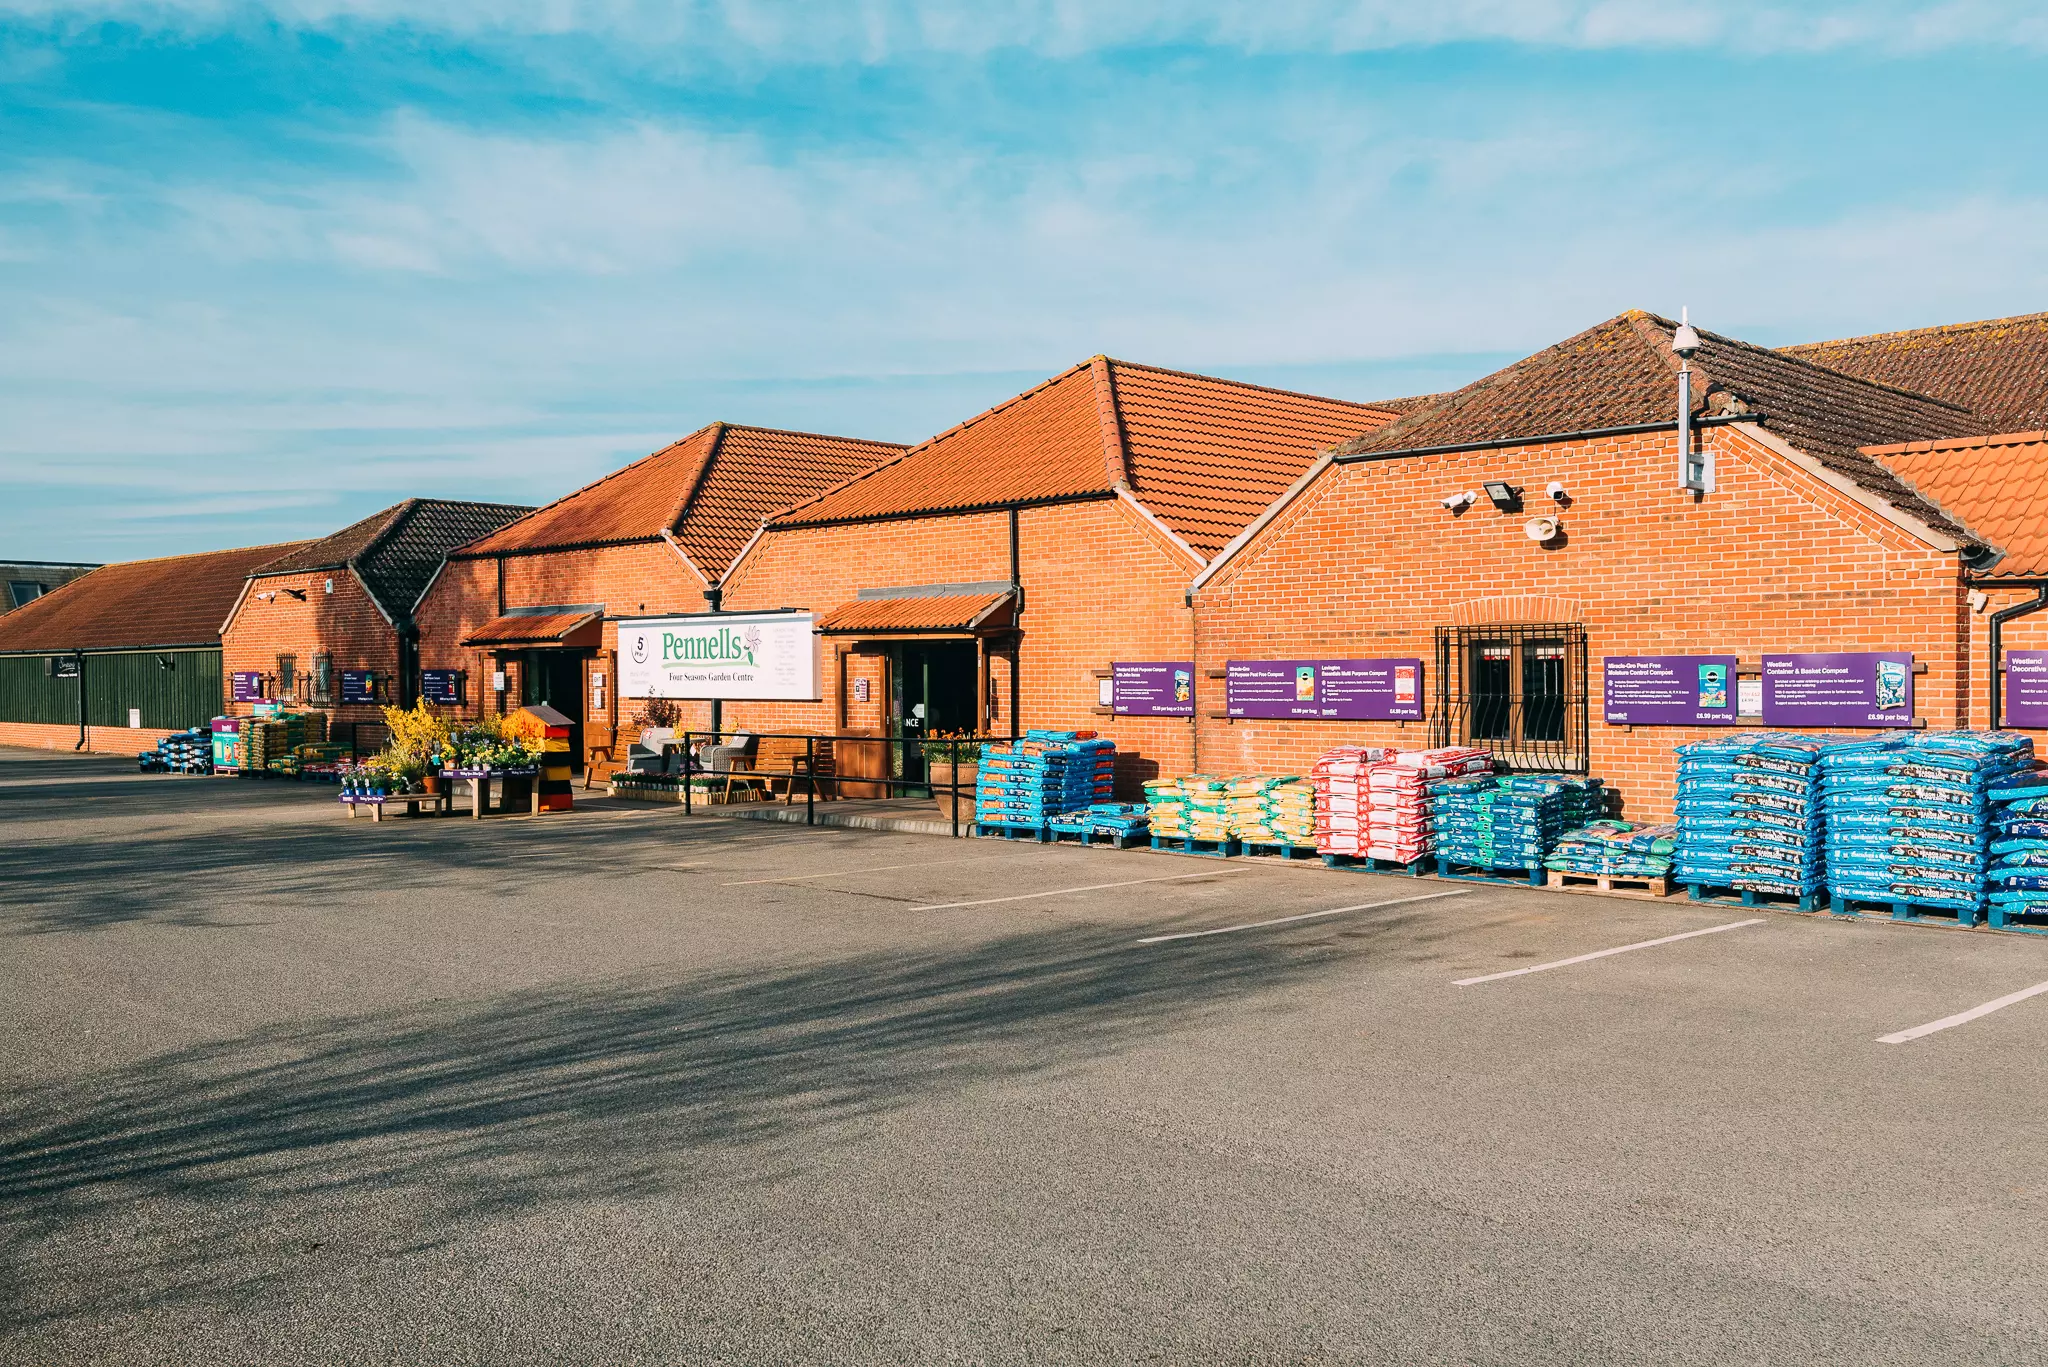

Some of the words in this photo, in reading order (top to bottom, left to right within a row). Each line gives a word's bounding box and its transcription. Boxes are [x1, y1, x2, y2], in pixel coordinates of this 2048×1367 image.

[638, 636, 643, 650] 5
[662, 628, 742, 660] Pennells
[669, 673, 683, 681] Four
[684, 673, 707, 681] Seasons
[708, 672, 731, 682] Garden
[732, 672, 754, 682] Centre
